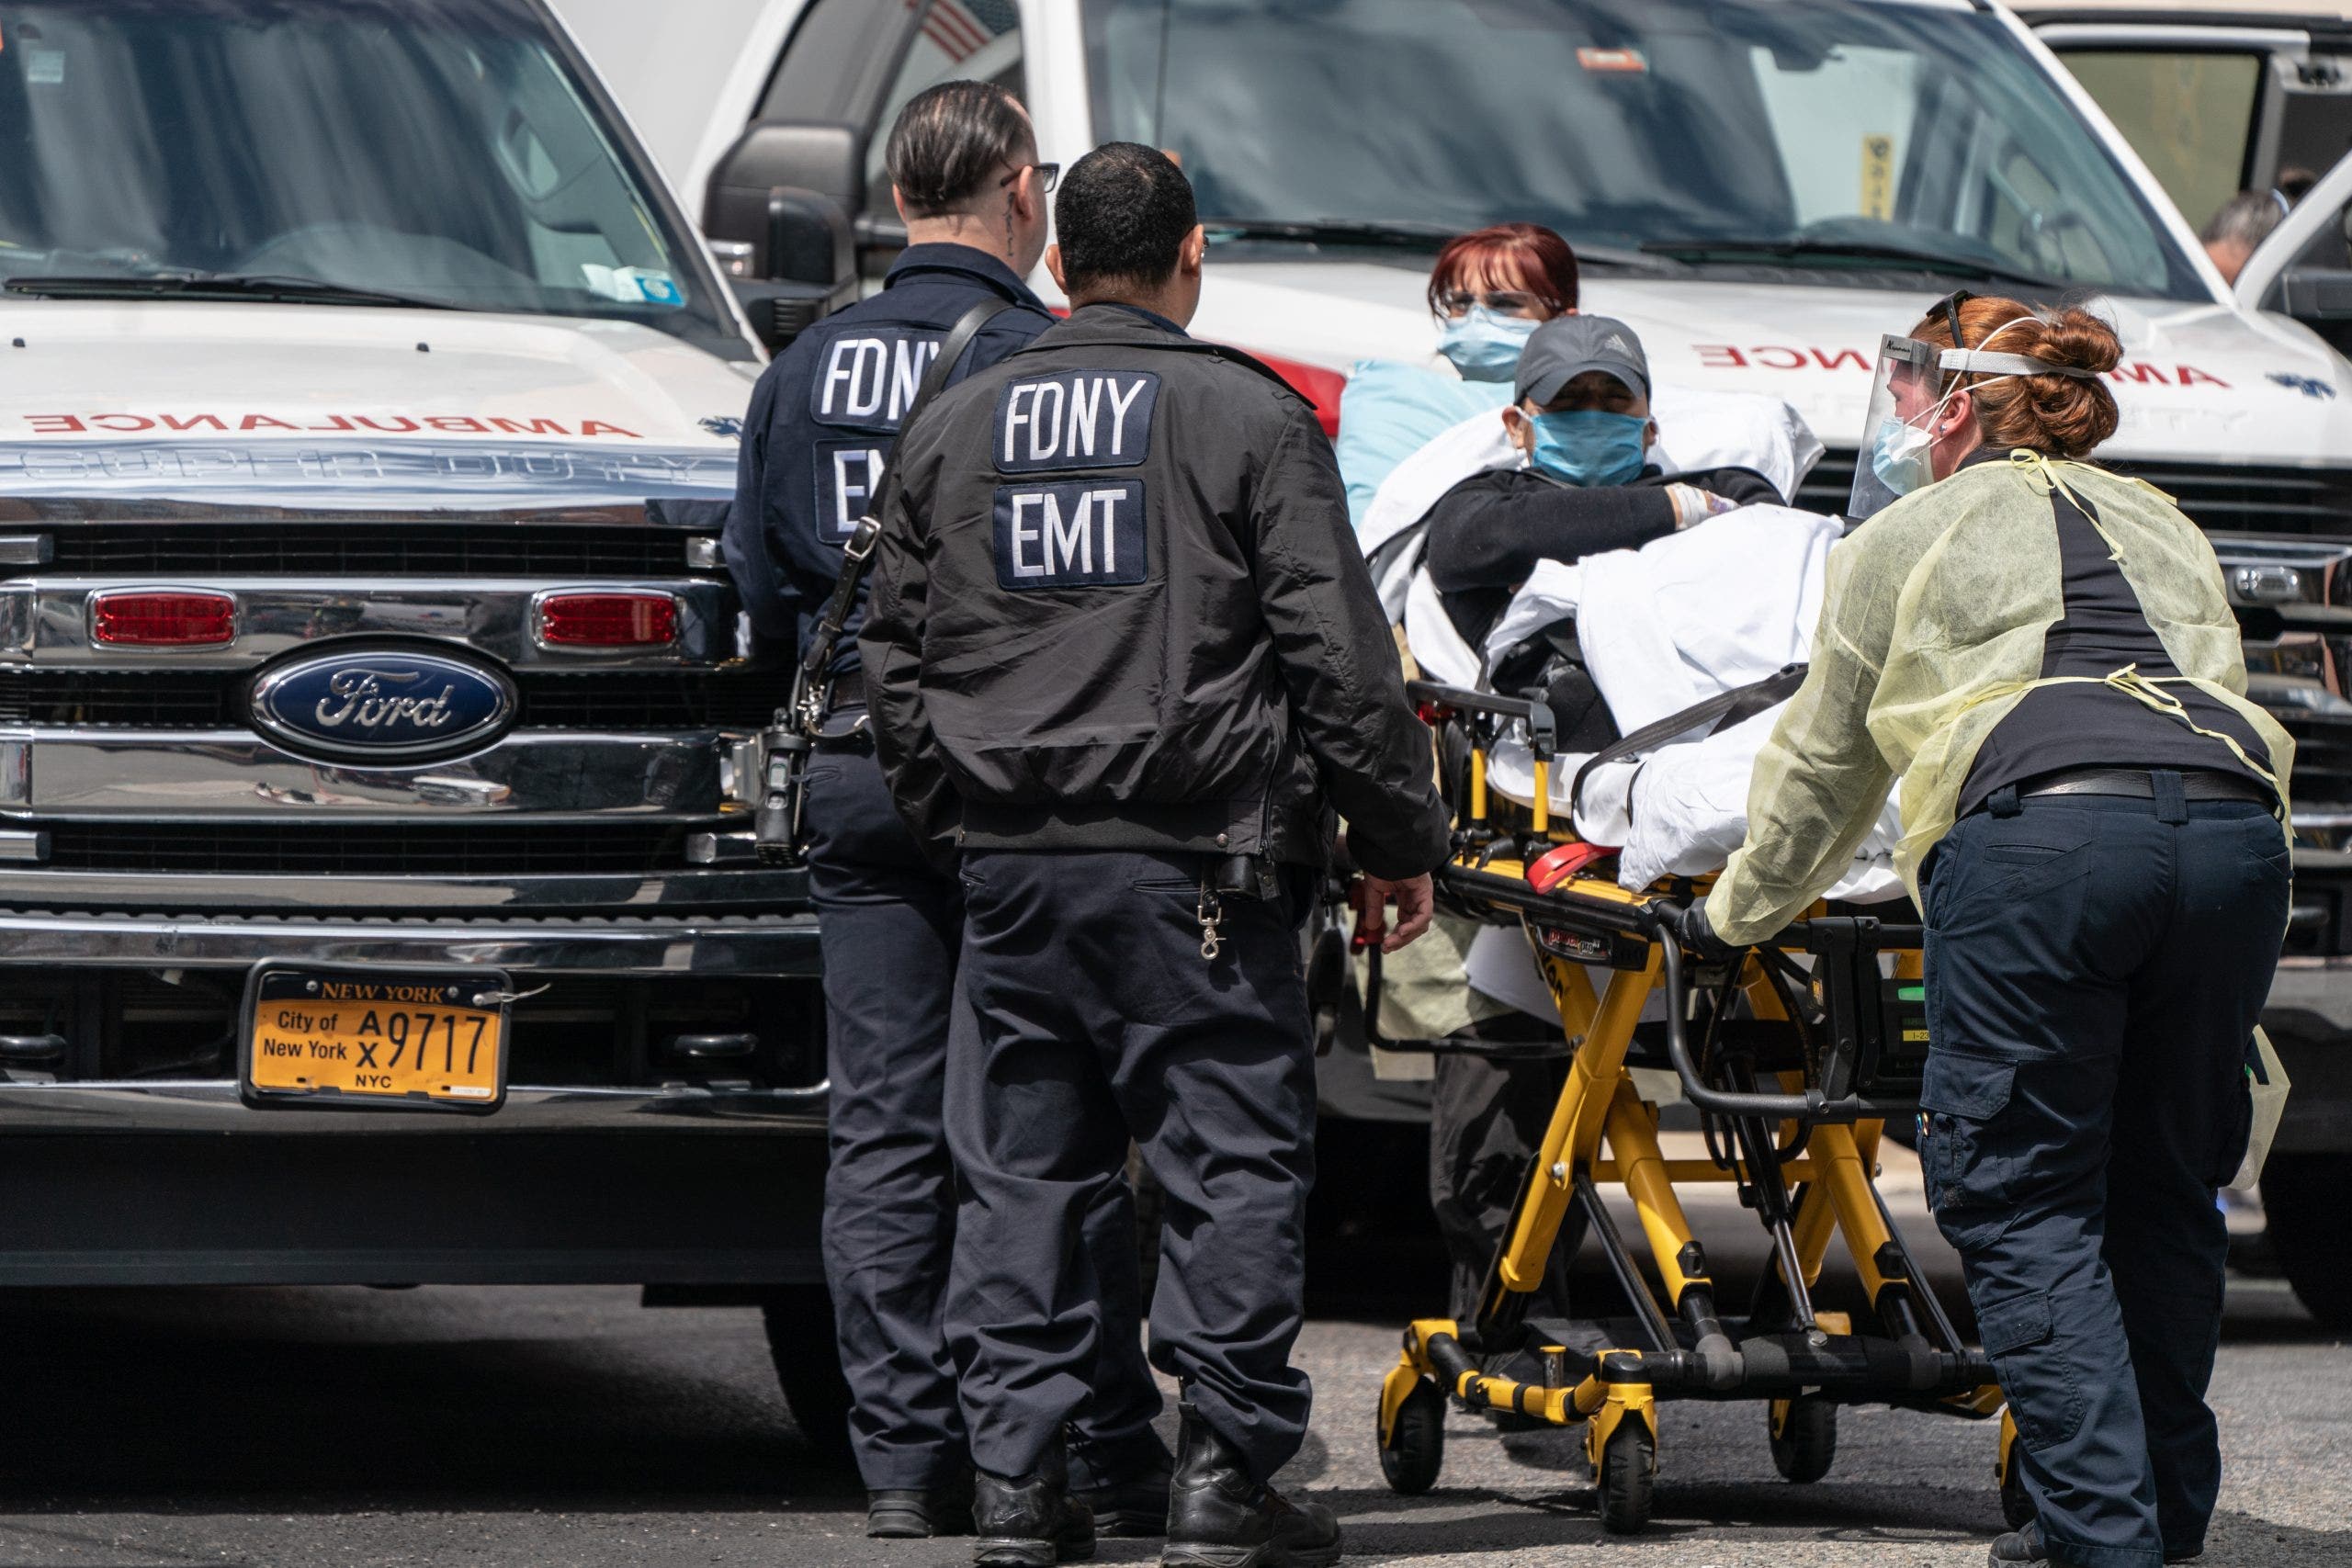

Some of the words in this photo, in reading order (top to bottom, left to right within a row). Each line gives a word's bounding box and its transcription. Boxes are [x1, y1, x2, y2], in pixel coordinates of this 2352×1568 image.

[820, 338, 940, 422] FDN
[1004, 378, 1147, 462] FDNY
[20, 449, 386, 479] SUPER
[433, 450, 701, 484] DUTY
[1012, 489, 1127, 578] EMT
[315, 668, 455, 727] Ford
[322, 982, 379, 1001] NEW
[385, 986, 446, 1004] YORK
[277, 1010, 313, 1033] City
[319, 1014, 339, 1032] of
[388, 1011, 487, 1074] 9717
[264, 1038, 303, 1056] New
[308, 1040, 347, 1060] York
[356, 1075, 392, 1089] NYC
